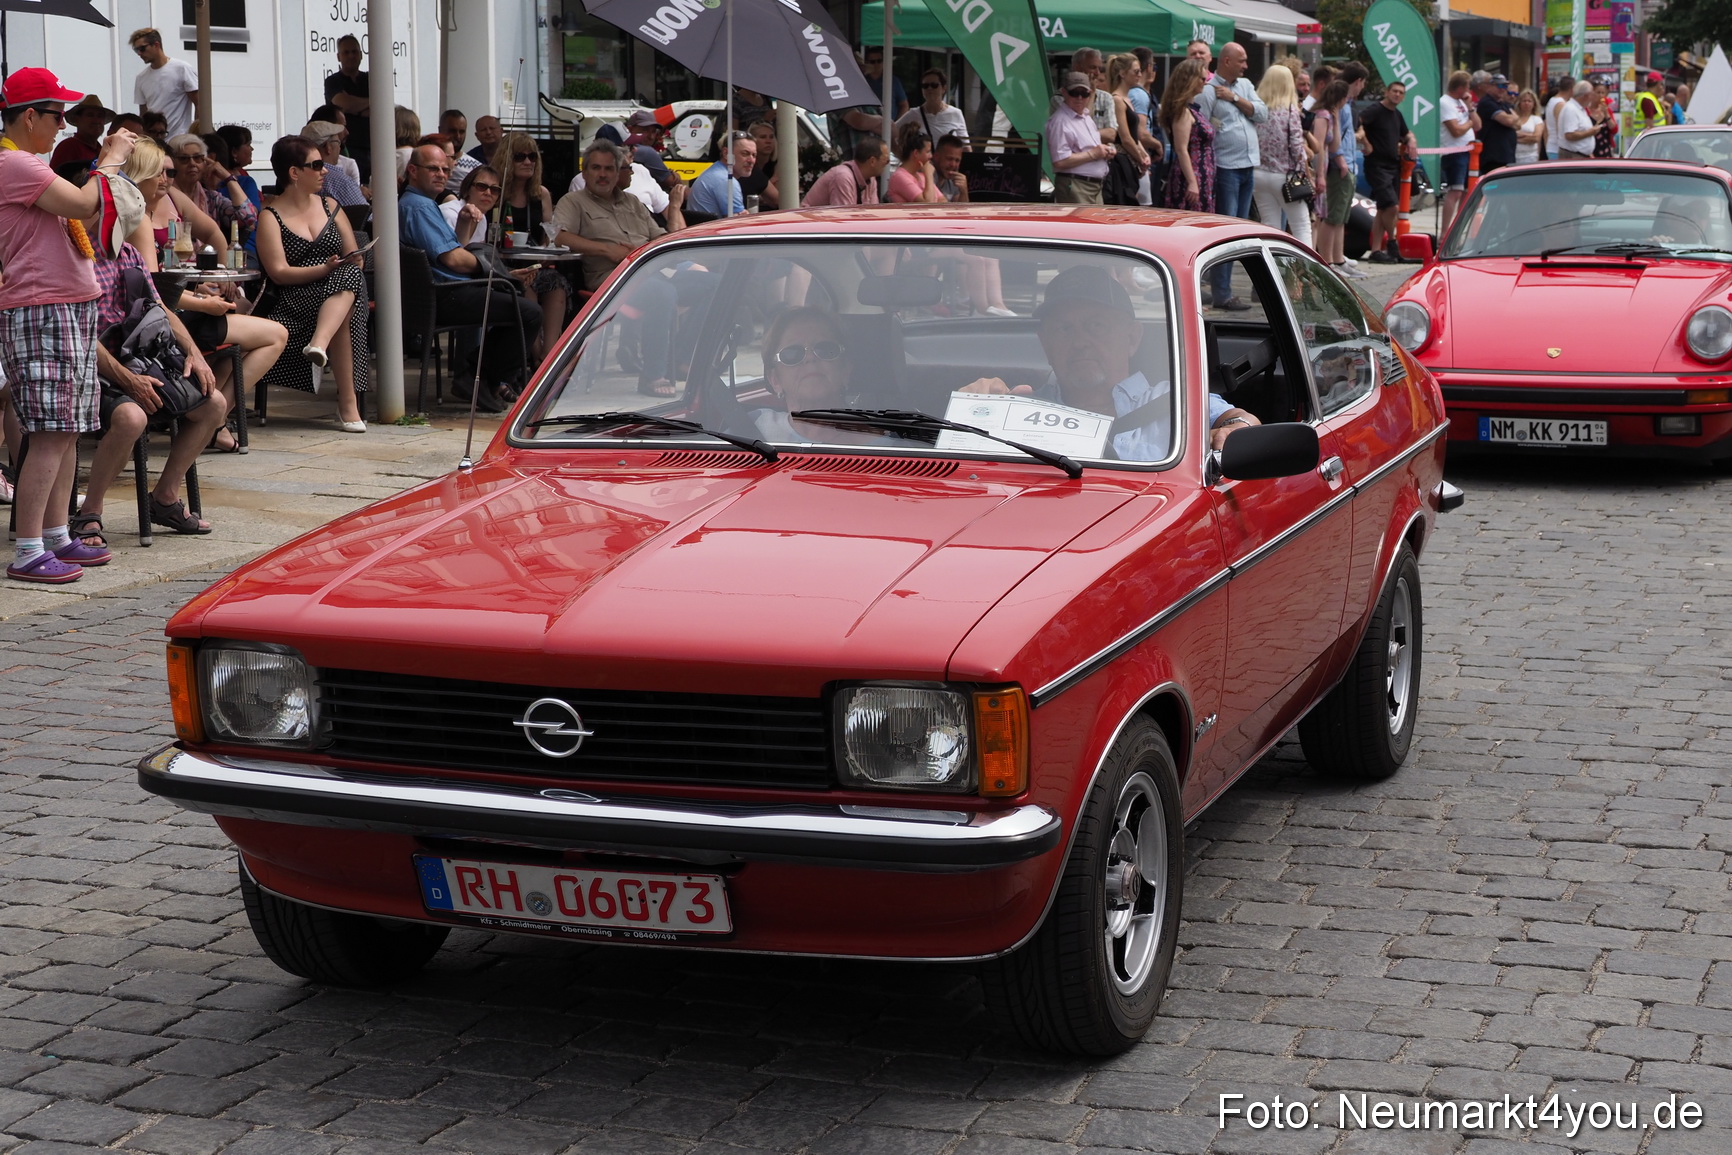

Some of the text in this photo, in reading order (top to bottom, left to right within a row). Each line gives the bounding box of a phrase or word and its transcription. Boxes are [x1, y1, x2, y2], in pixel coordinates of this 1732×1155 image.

[330, 0, 349, 22] 30
[310, 30, 336, 53] Ban
[690, 129, 697, 138] 6
[1023, 411, 1080, 430] 496
[1491, 420, 1515, 440] NM
[1529, 421, 1553, 441] KK
[1559, 423, 1593, 442] 911
[432, 866, 715, 924] D RH 06073
[500, 919, 551, 930] Schmidtmeier
[633, 931, 677, 941] 08469/494
